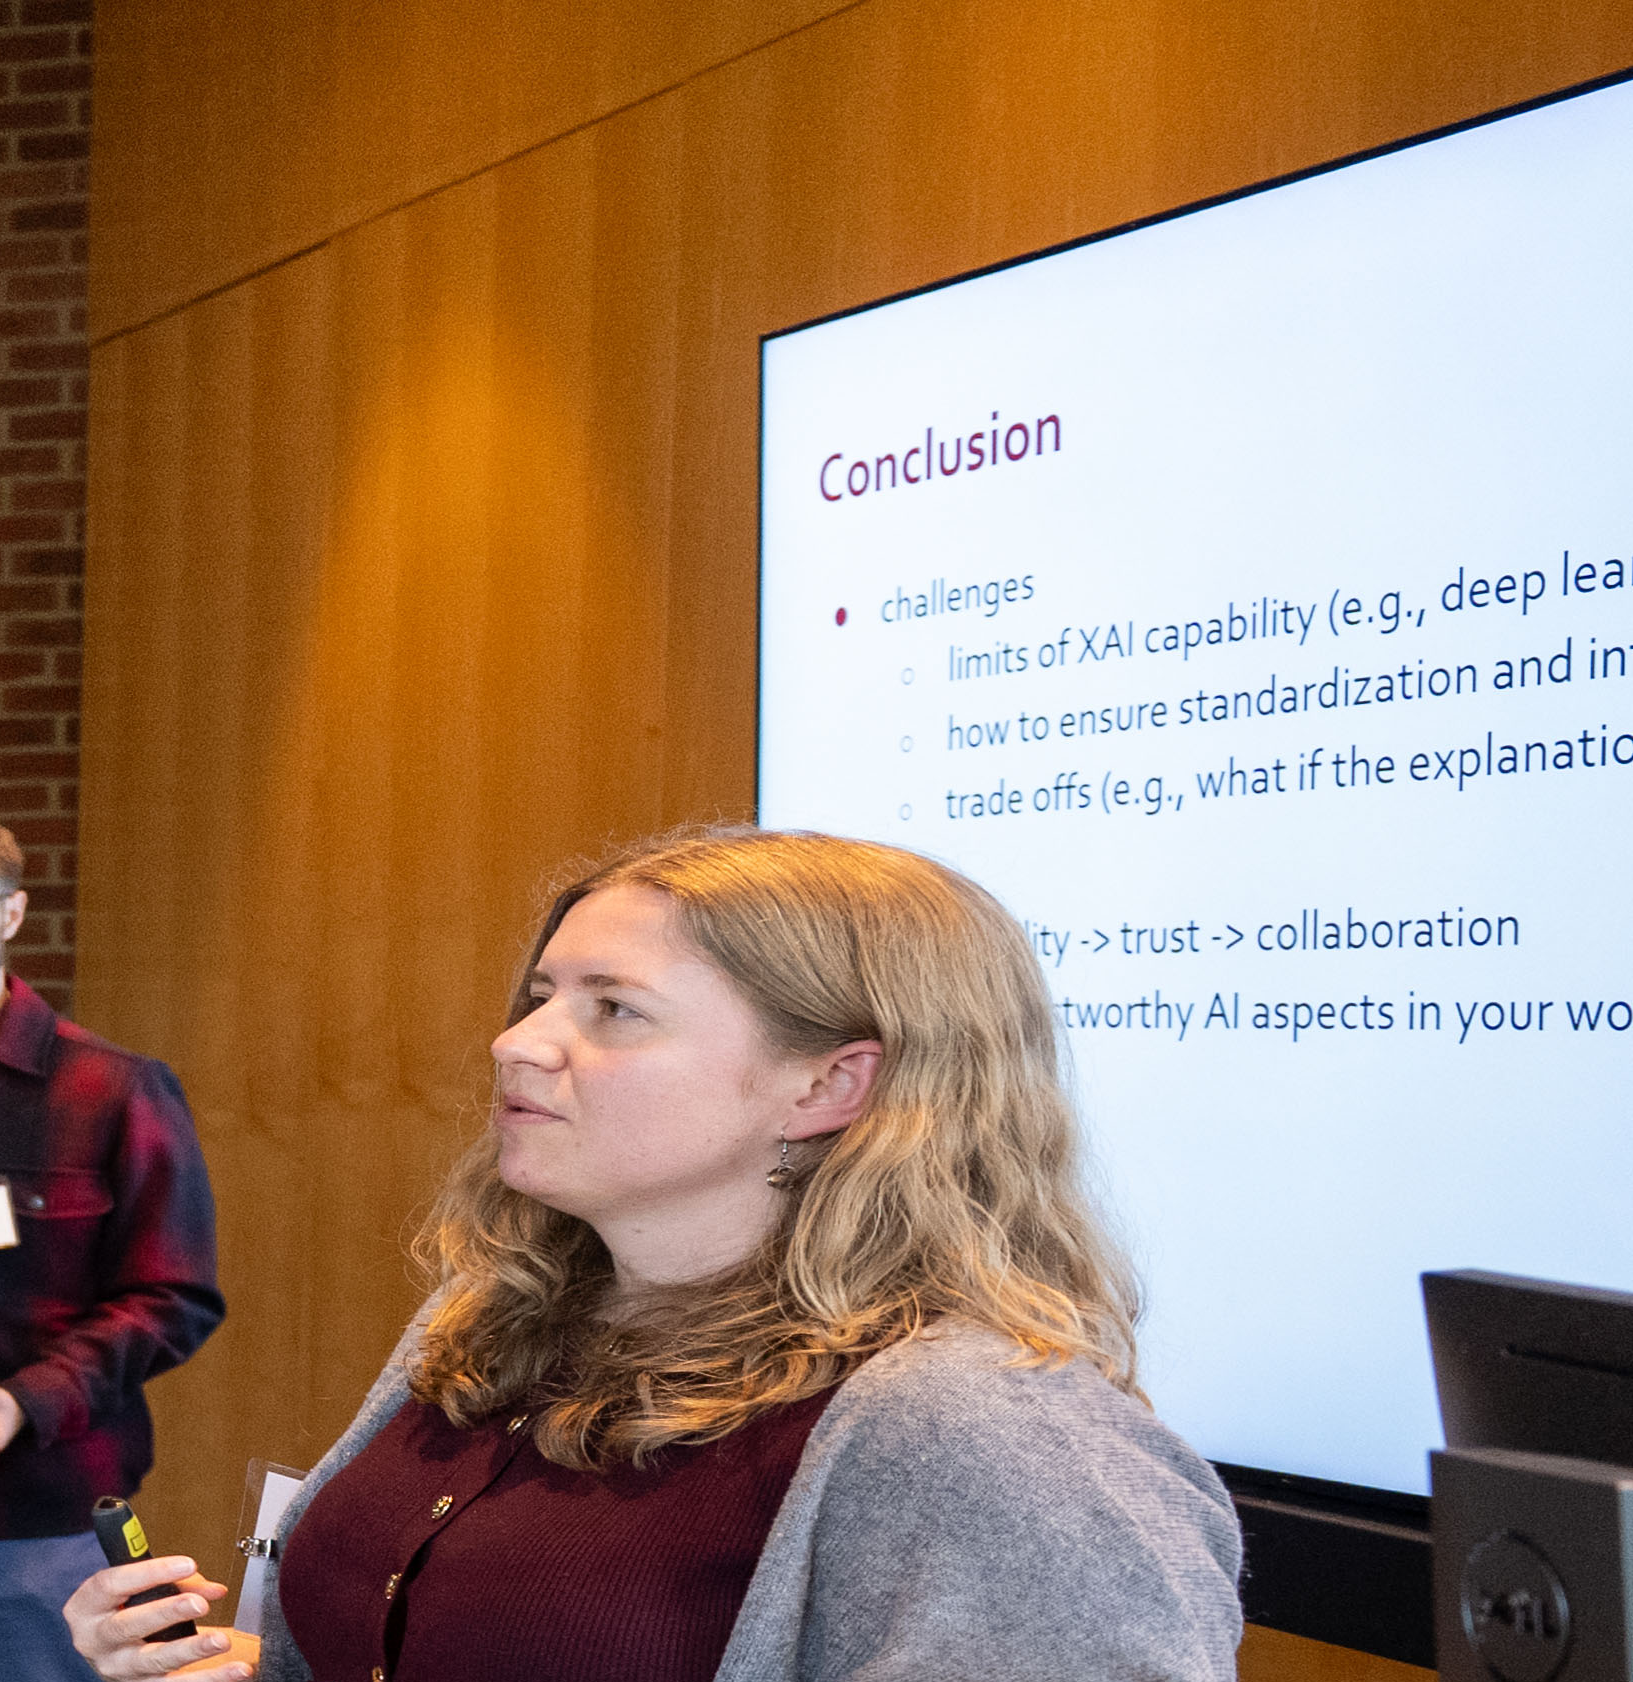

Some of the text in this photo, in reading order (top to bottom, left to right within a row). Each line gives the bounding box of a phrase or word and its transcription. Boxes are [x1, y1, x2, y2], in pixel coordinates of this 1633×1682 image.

[819, 411, 1062, 502] Conclusion
[880, 575, 1035, 623] challenges
[949, 550, 1633, 681] limits of XAI capability (e.g., deep lea
[948, 636, 1633, 750] how to ensure standardization and in
[946, 778, 1023, 819] trade
[1033, 771, 1092, 812] offs
[1101, 770, 1184, 816] (e.g.,
[1196, 756, 1286, 798] what
[1299, 747, 1324, 791] if
[1332, 744, 1395, 788] the
[1120, 920, 1201, 954] trust
[1257, 906, 1519, 951] collaboration
[1061, 989, 1195, 1042] tworthy
[1204, 992, 1239, 1029] AI
[1252, 995, 1394, 1042] aspects
[1409, 991, 1441, 1030] in
[1455, 1001, 1554, 1044] your
